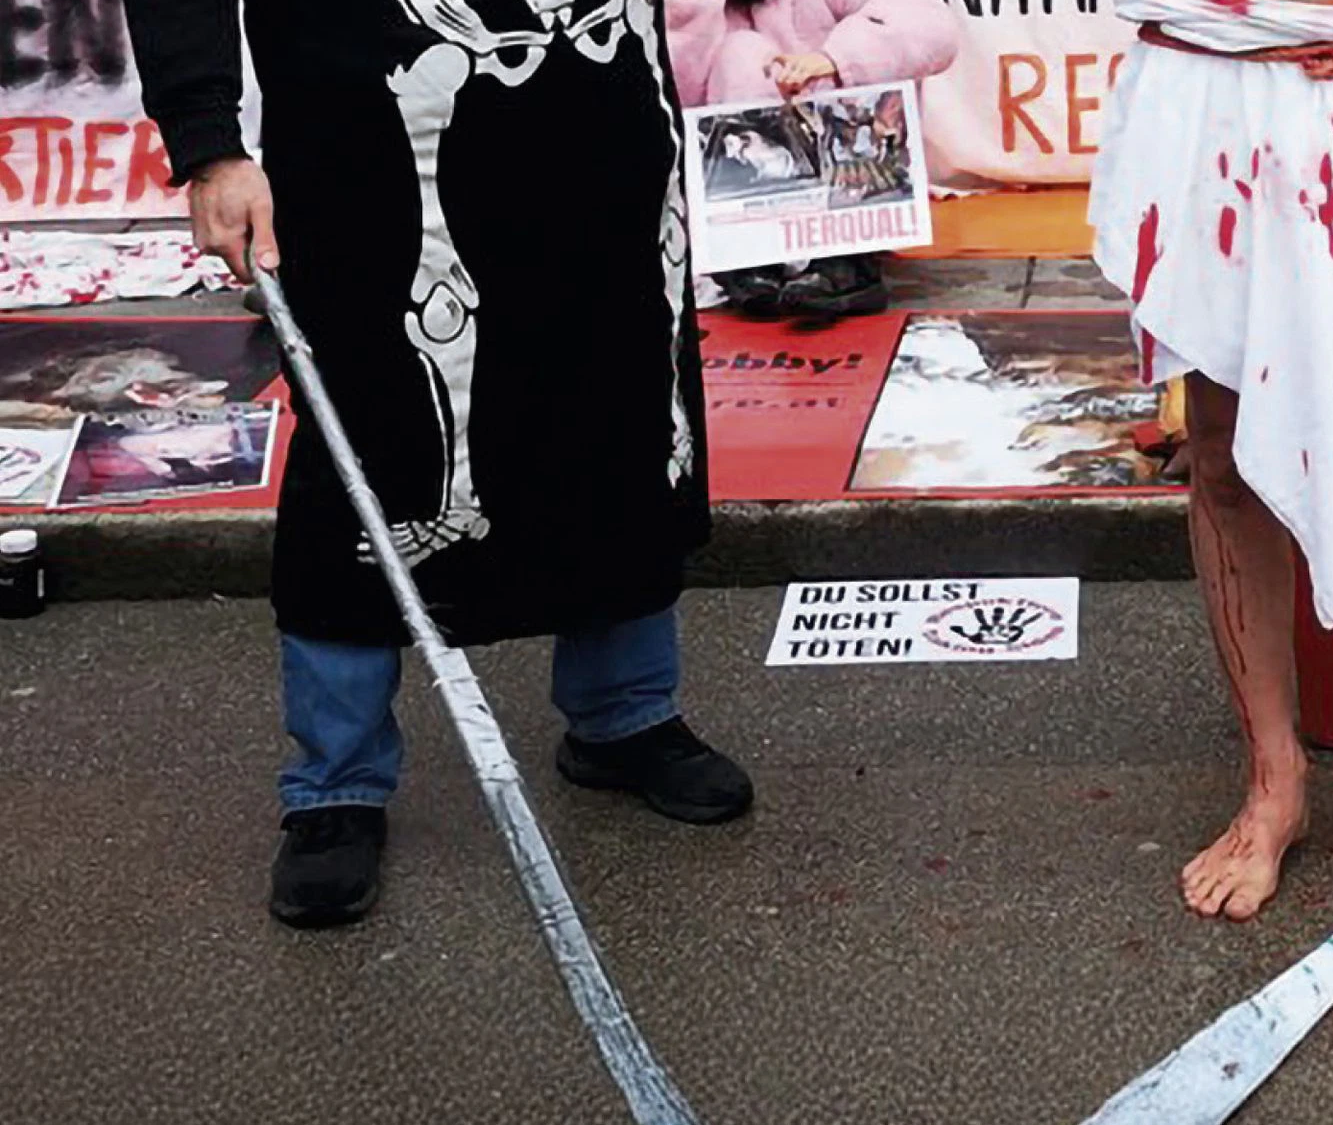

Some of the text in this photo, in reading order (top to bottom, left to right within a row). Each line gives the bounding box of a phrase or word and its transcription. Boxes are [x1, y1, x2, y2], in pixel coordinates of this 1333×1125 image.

[998, 53, 1126, 155] RE
[800, 583, 983, 605] DU SOLLST
[792, 611, 901, 631] NICHT
[787, 638, 913, 659] TÖTEN!
